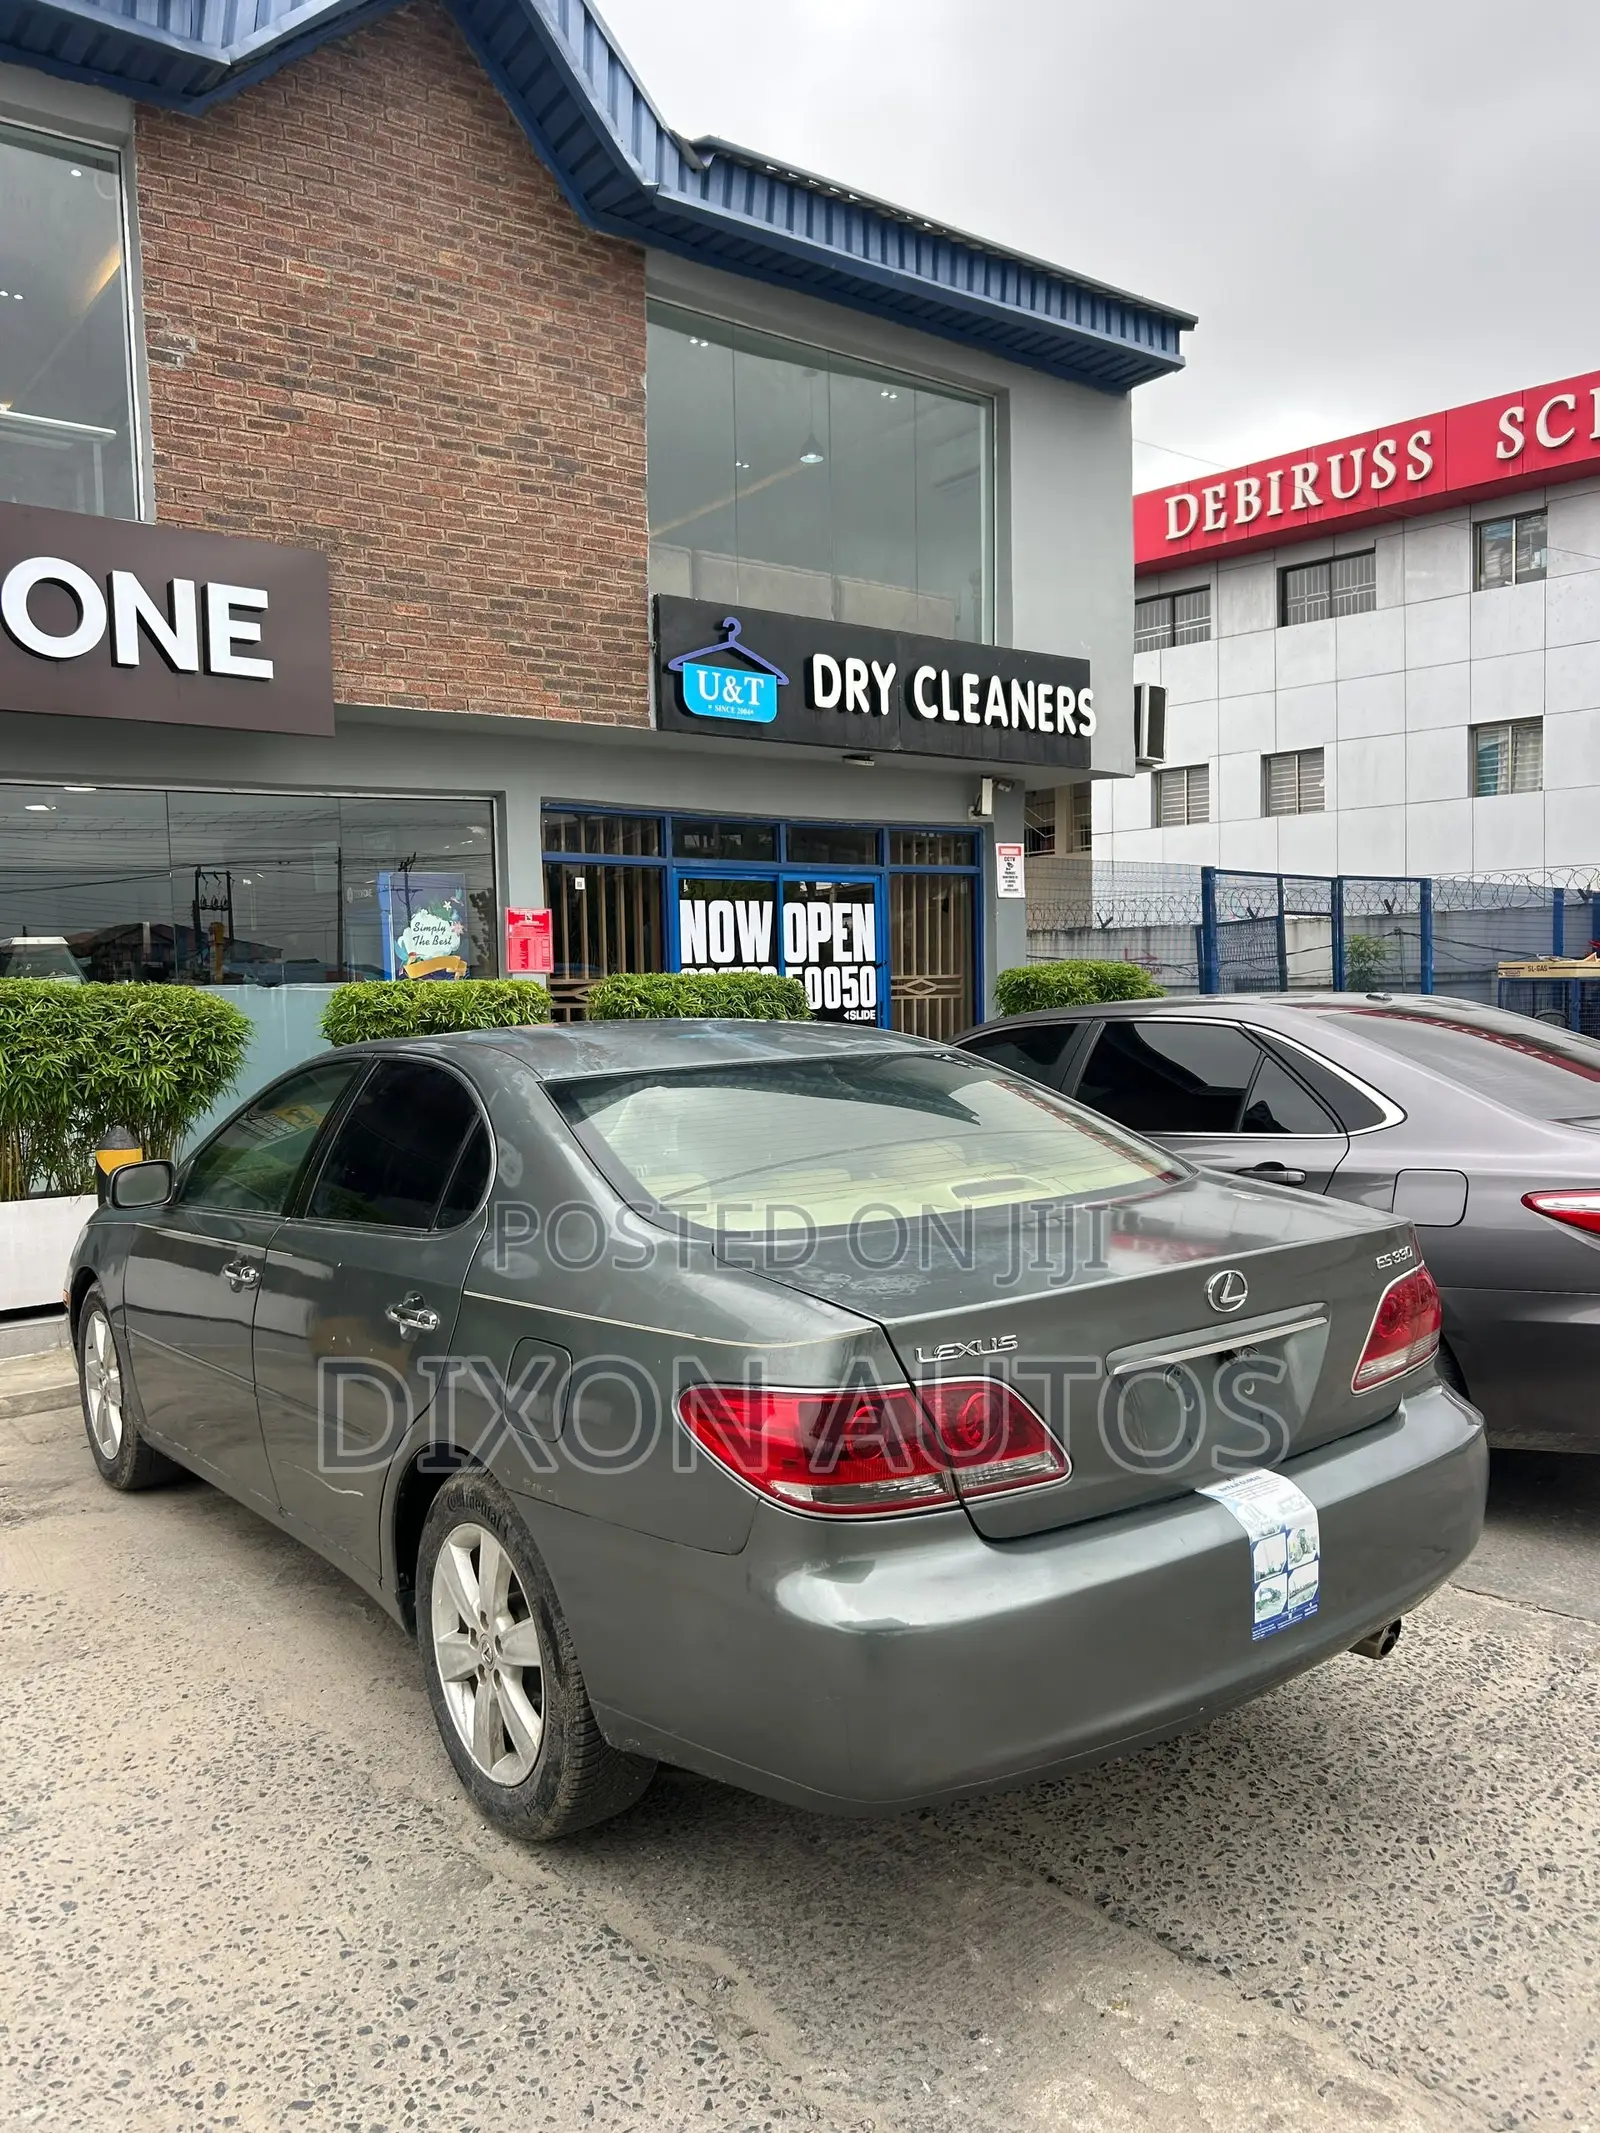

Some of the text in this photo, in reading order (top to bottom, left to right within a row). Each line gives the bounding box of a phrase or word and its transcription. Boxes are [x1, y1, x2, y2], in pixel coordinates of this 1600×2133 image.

[1164, 429, 1434, 541] DEBIRUSS
[0, 556, 274, 681] ONE
[696, 670, 765, 706] U&T
[812, 653, 1097, 737] DRY CLEANERS
[714, 704, 736, 714] SINCE
[412, 934, 453, 946] The Best
[413, 921, 446, 936] Simply
[679, 899, 876, 964] NOW OPEN
[849, 1009, 876, 1021] SLIDE
[915, 1334, 1018, 1364] LEXUS
